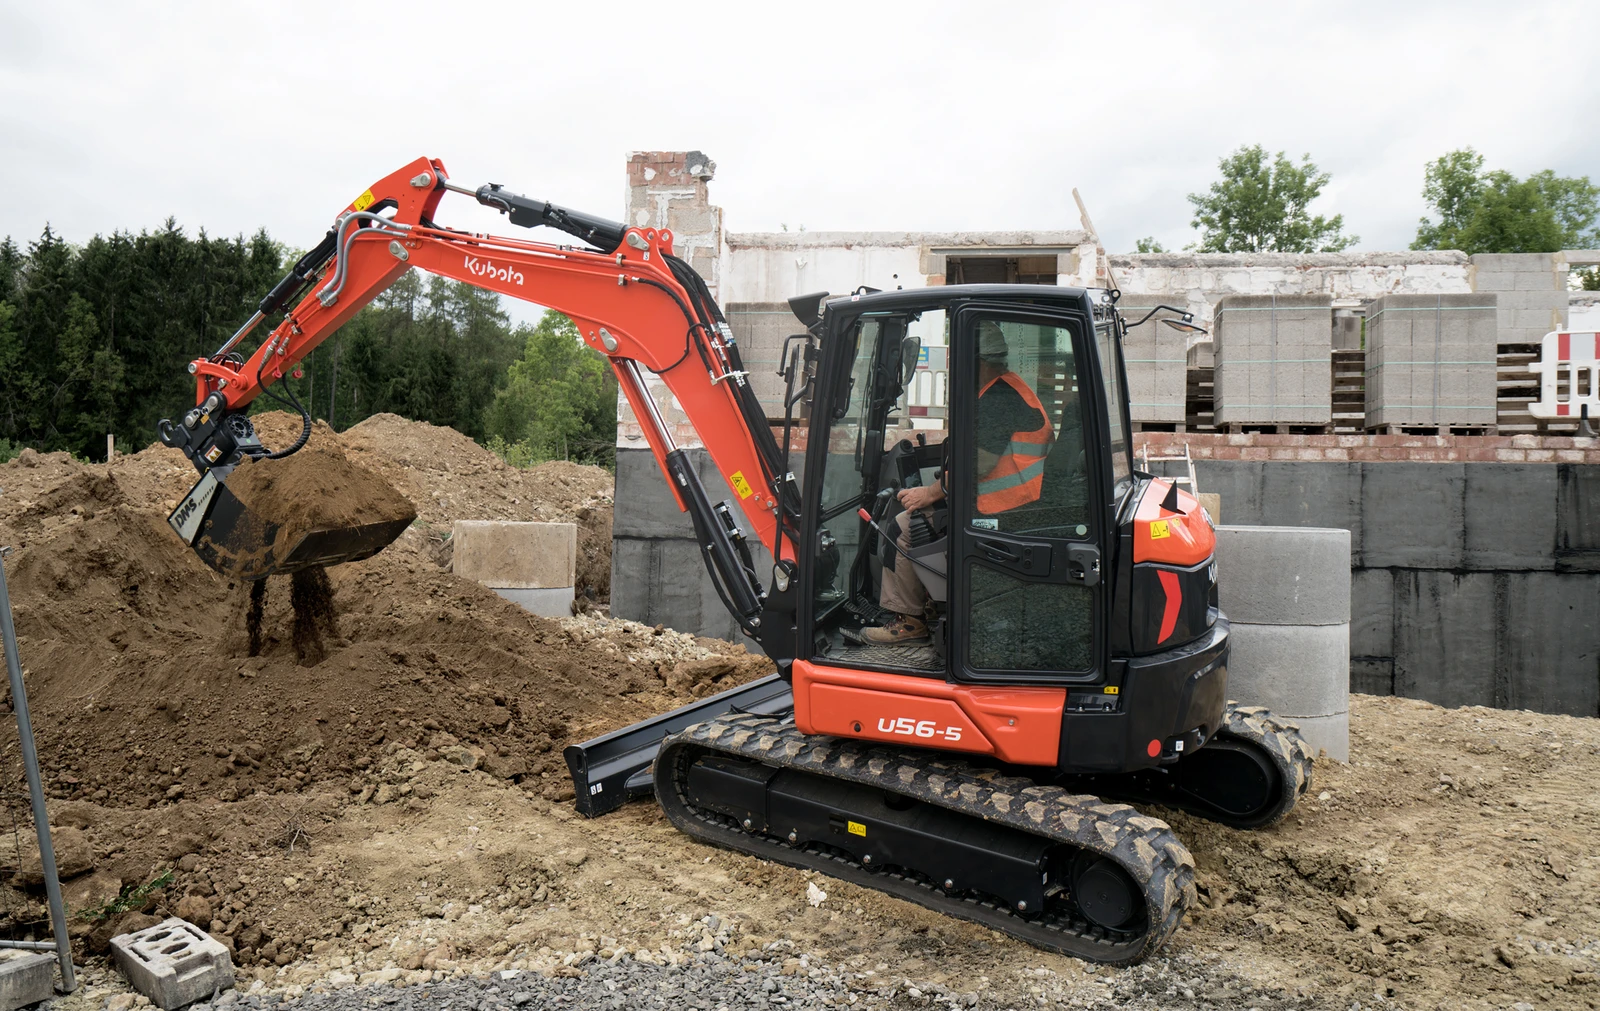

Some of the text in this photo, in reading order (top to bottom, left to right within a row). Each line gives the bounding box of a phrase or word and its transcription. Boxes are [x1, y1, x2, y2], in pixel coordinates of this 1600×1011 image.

[464, 256, 524, 285] Kubota
[174, 498, 197, 528] DMS
[878, 717, 962, 741] U56-5
